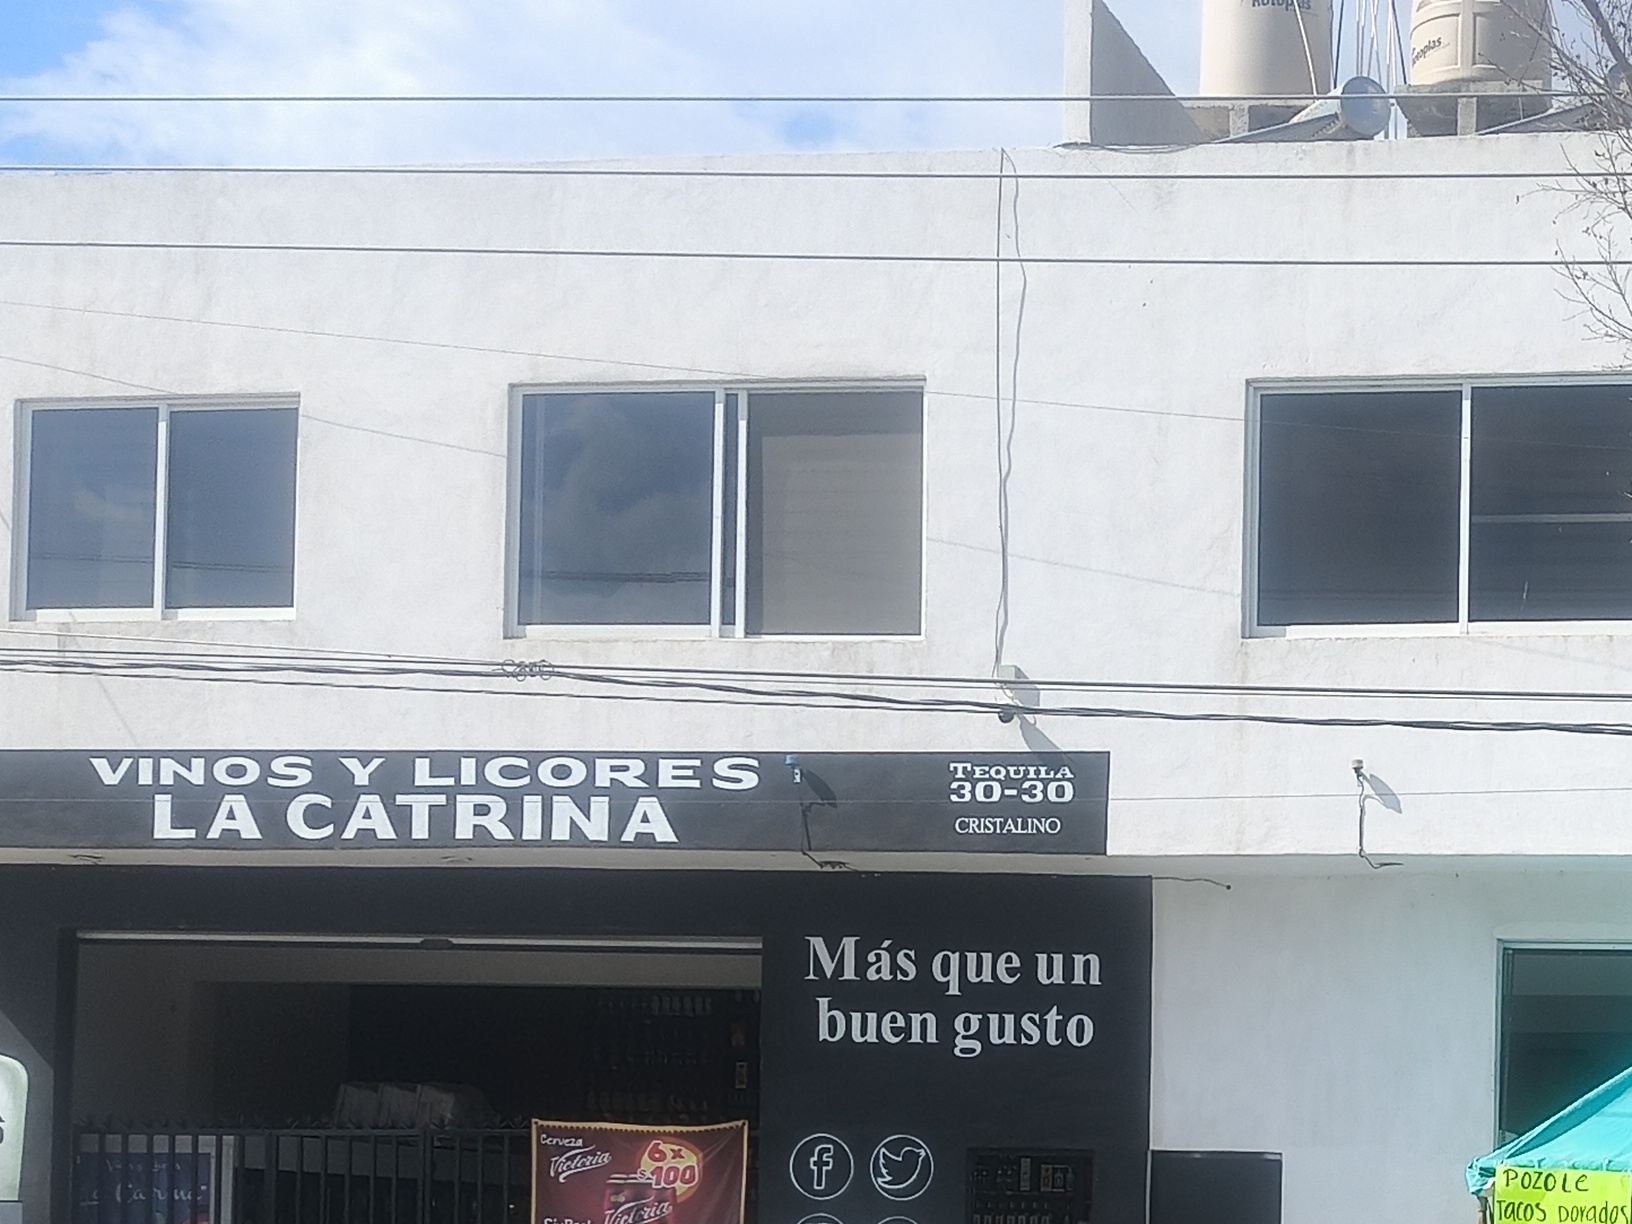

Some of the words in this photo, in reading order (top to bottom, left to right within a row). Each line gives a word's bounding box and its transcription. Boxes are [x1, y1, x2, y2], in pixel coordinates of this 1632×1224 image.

[89, 756, 313, 788] VINOS
[338, 758, 386, 786] Y
[414, 757, 760, 790] LICORES
[950, 781, 1075, 803] 30-30
[153, 794, 263, 840] LA
[286, 793, 679, 844] CATRINA
[954, 817, 1062, 835] CRISTALINO
[804, 936, 917, 981] Más
[931, 950, 1021, 995] que
[1035, 952, 1101, 985] un
[816, 997, 939, 1044] buen
[953, 1005, 1094, 1058] gusto
[540, 1134, 583, 1147] Cerveza
[550, 1144, 613, 1182] Victoria
